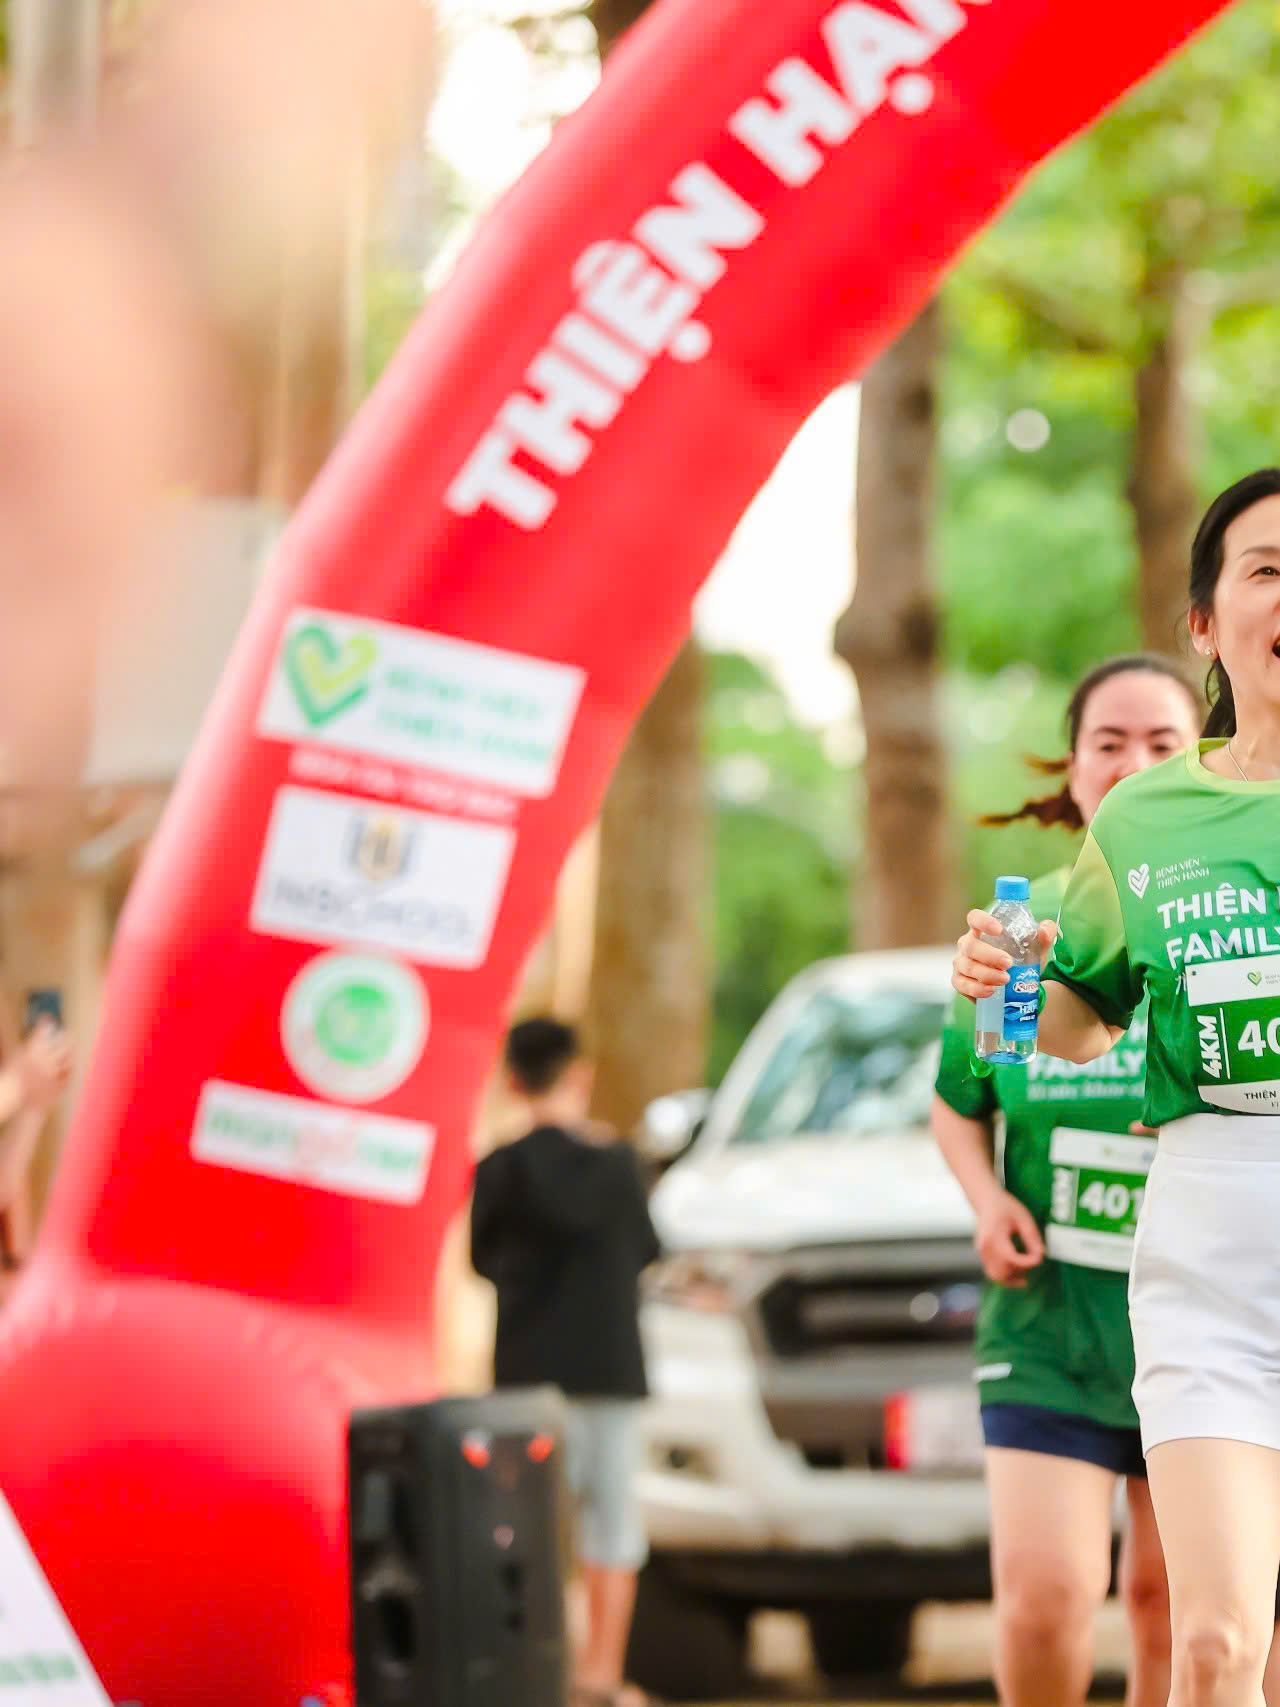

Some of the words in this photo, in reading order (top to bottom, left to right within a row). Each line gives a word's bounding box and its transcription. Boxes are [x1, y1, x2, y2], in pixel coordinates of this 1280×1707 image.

[444, 161, 766, 531] THIỆN
[729, 0, 992, 188] HẠ
[1157, 882, 1267, 929] THIỆN
[1196, 1015, 1223, 1078] 4KM
[1244, 1090, 1277, 1101] THIỆN
